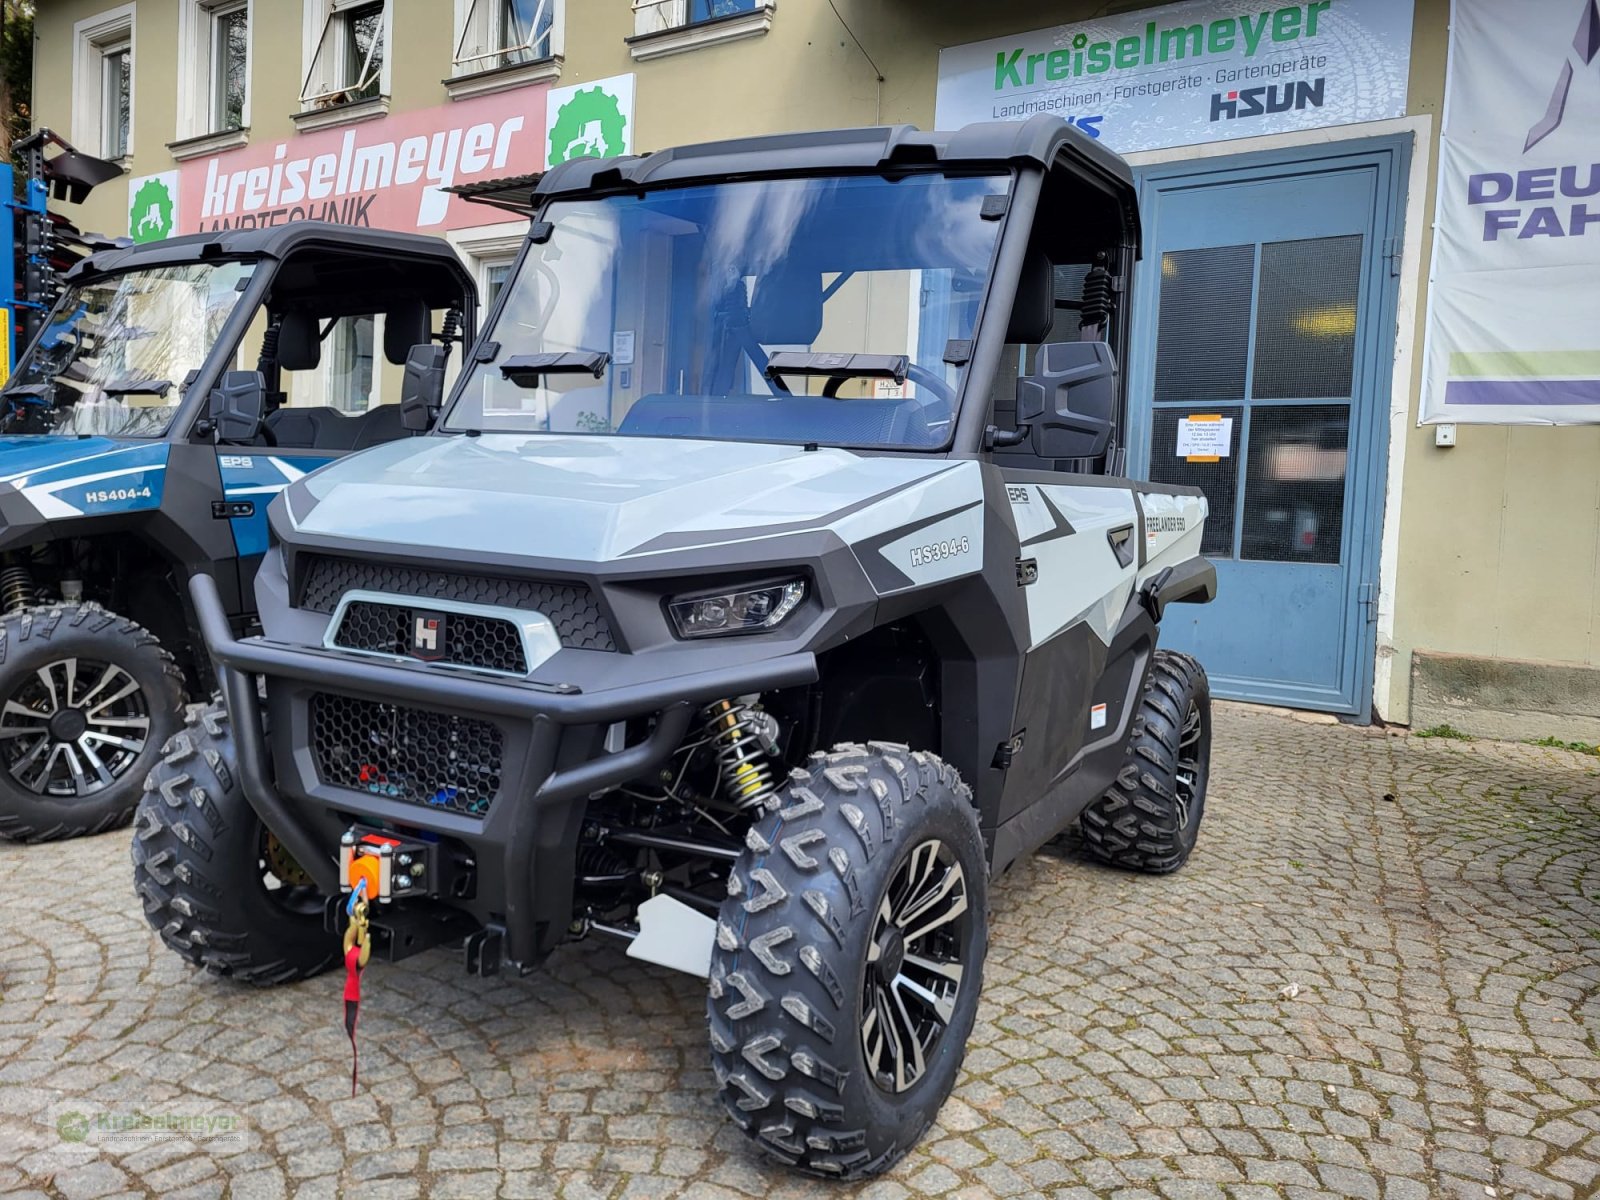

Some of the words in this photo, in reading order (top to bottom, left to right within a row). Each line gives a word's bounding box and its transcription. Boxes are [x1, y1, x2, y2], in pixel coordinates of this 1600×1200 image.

[994, 0, 1331, 90] Kreiselmeyer
[992, 92, 1102, 119] Landmaschinen
[1113, 74, 1203, 100] Forstgeräte
[1215, 55, 1327, 84] Gartengeräte
[201, 115, 525, 227] kreiselmeyer
[220, 456, 253, 467] EPS
[86, 487, 151, 503] HS404-4
[1007, 487, 1029, 501] EPS
[1146, 516, 1176, 532] FREELANDER
[1177, 516, 1185, 531] 550
[910, 536, 969, 567] HS394-6
